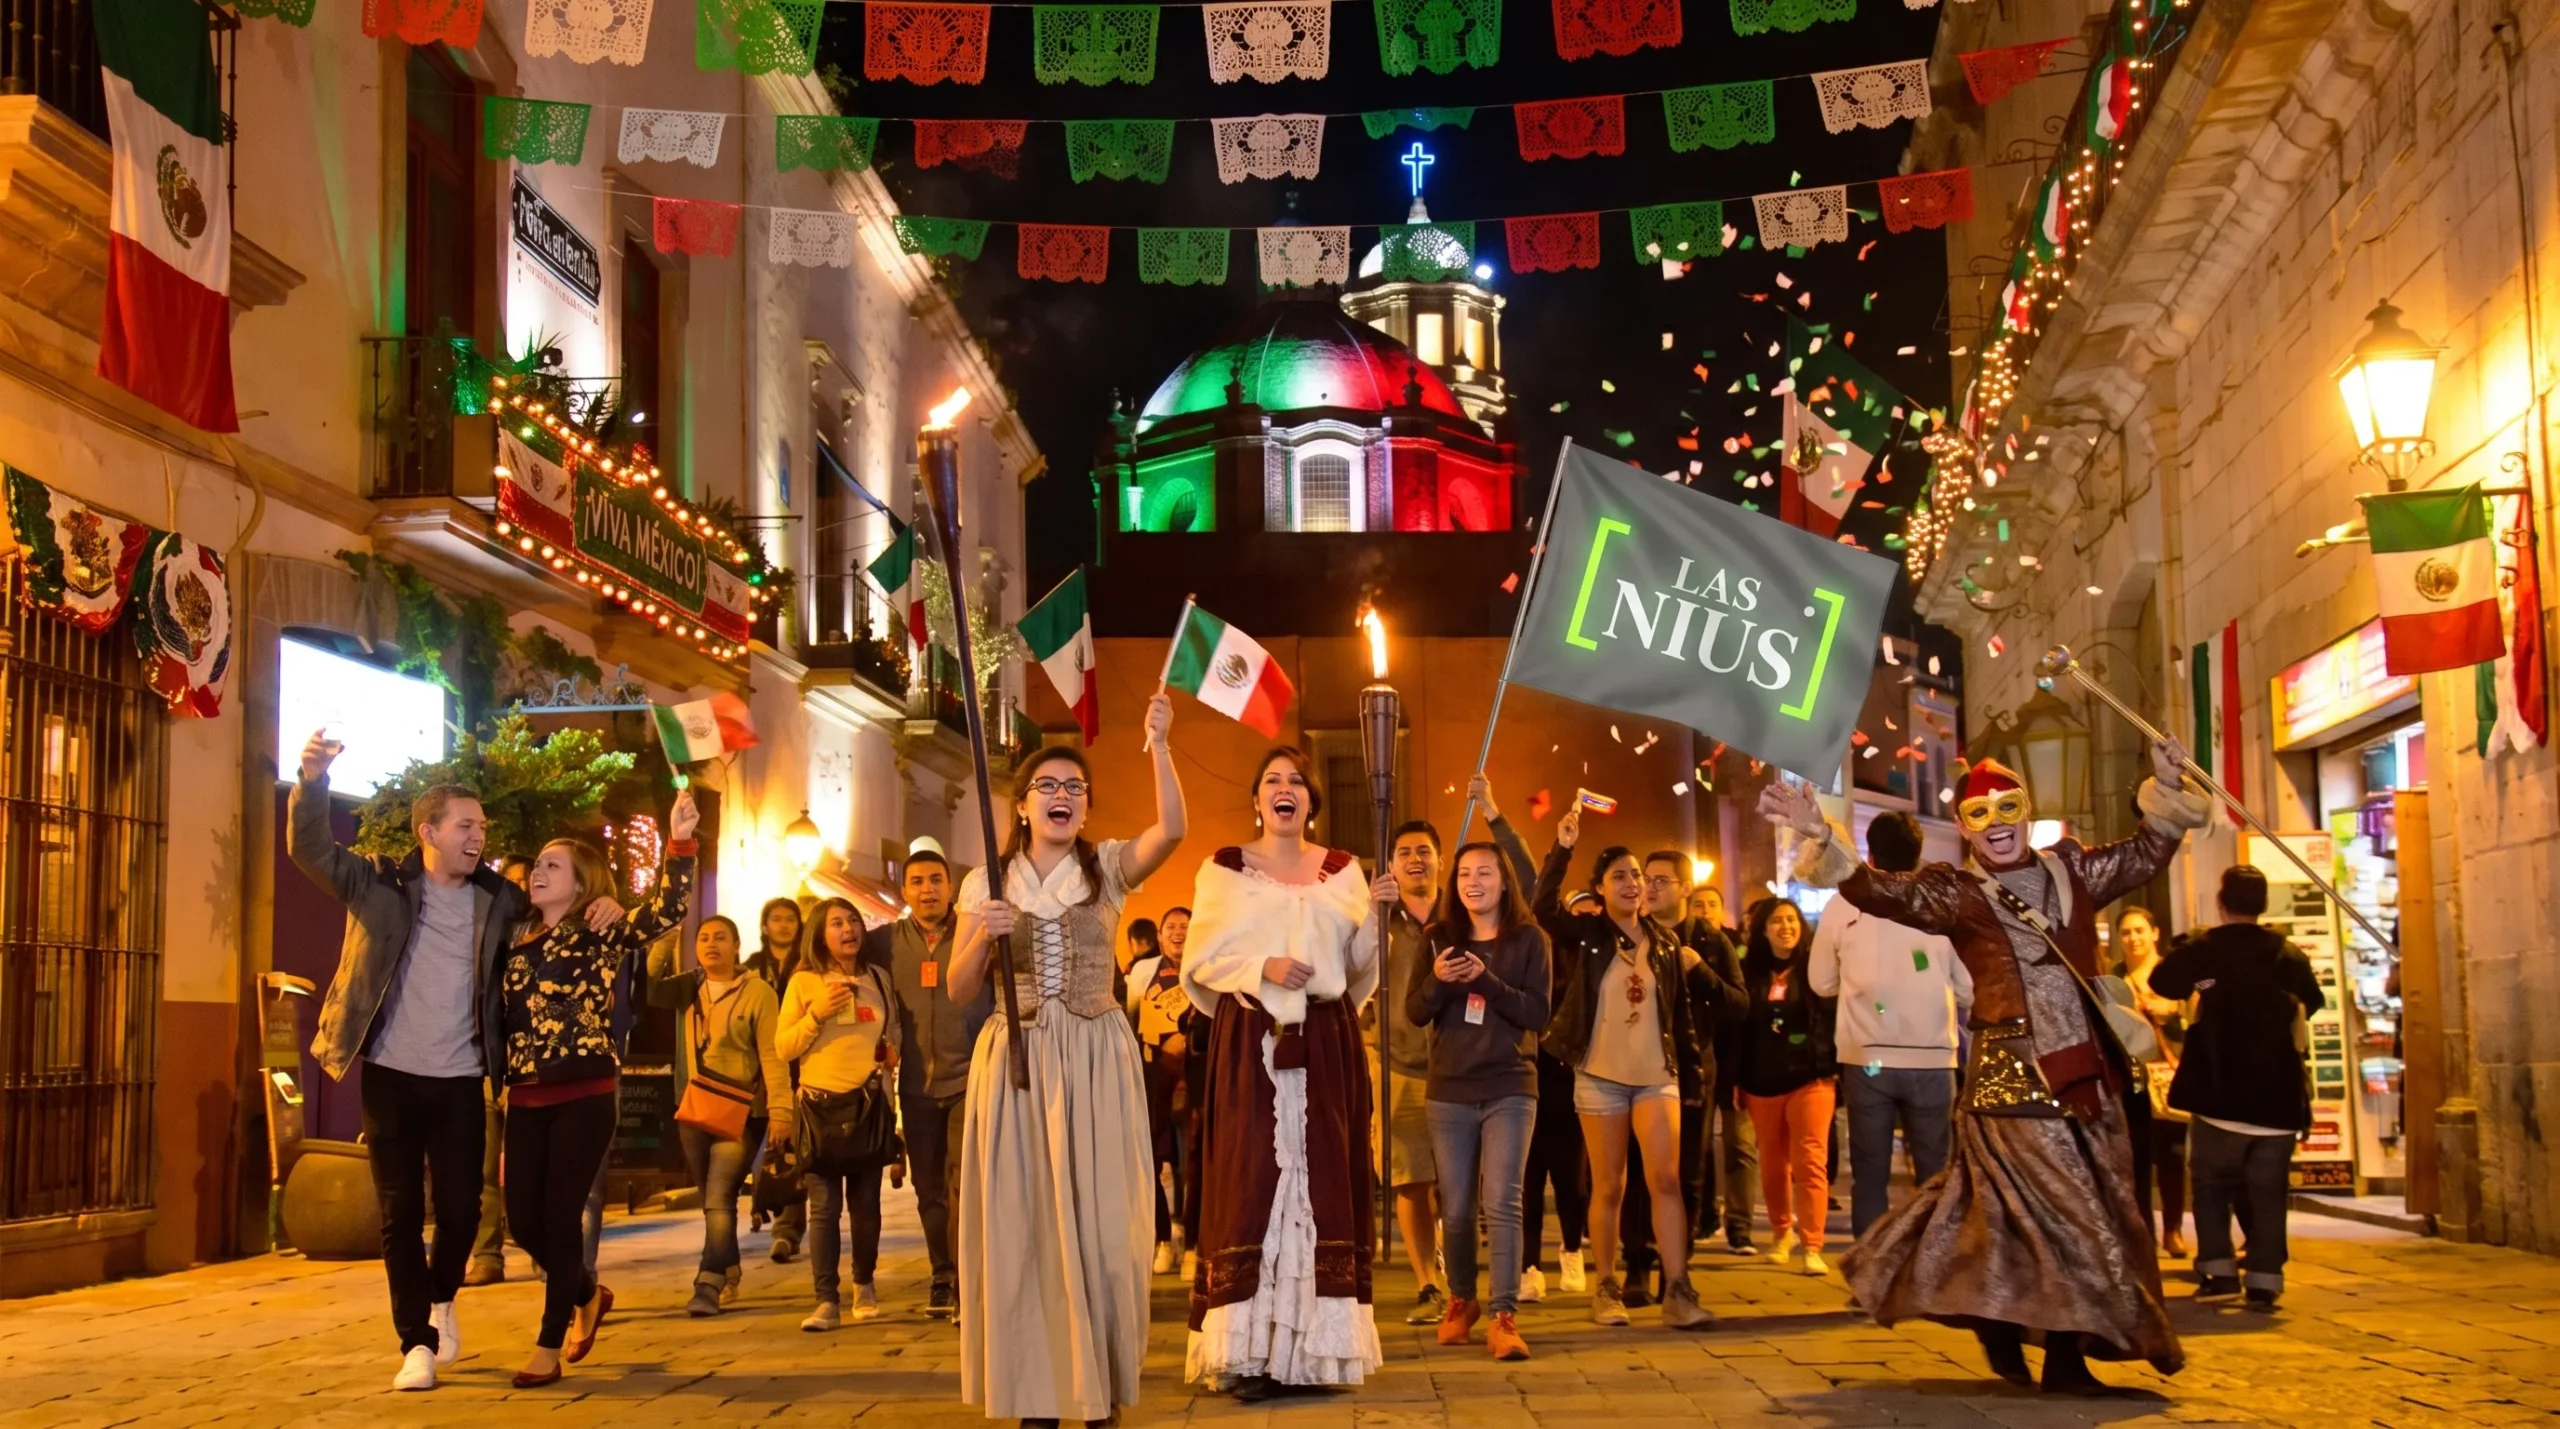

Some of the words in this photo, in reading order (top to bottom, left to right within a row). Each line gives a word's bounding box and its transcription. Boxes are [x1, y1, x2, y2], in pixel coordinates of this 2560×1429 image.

[584, 486, 632, 555] ¡VIVA
[1670, 556, 1762, 612] LAS
[1601, 578, 1799, 690] NIUS
